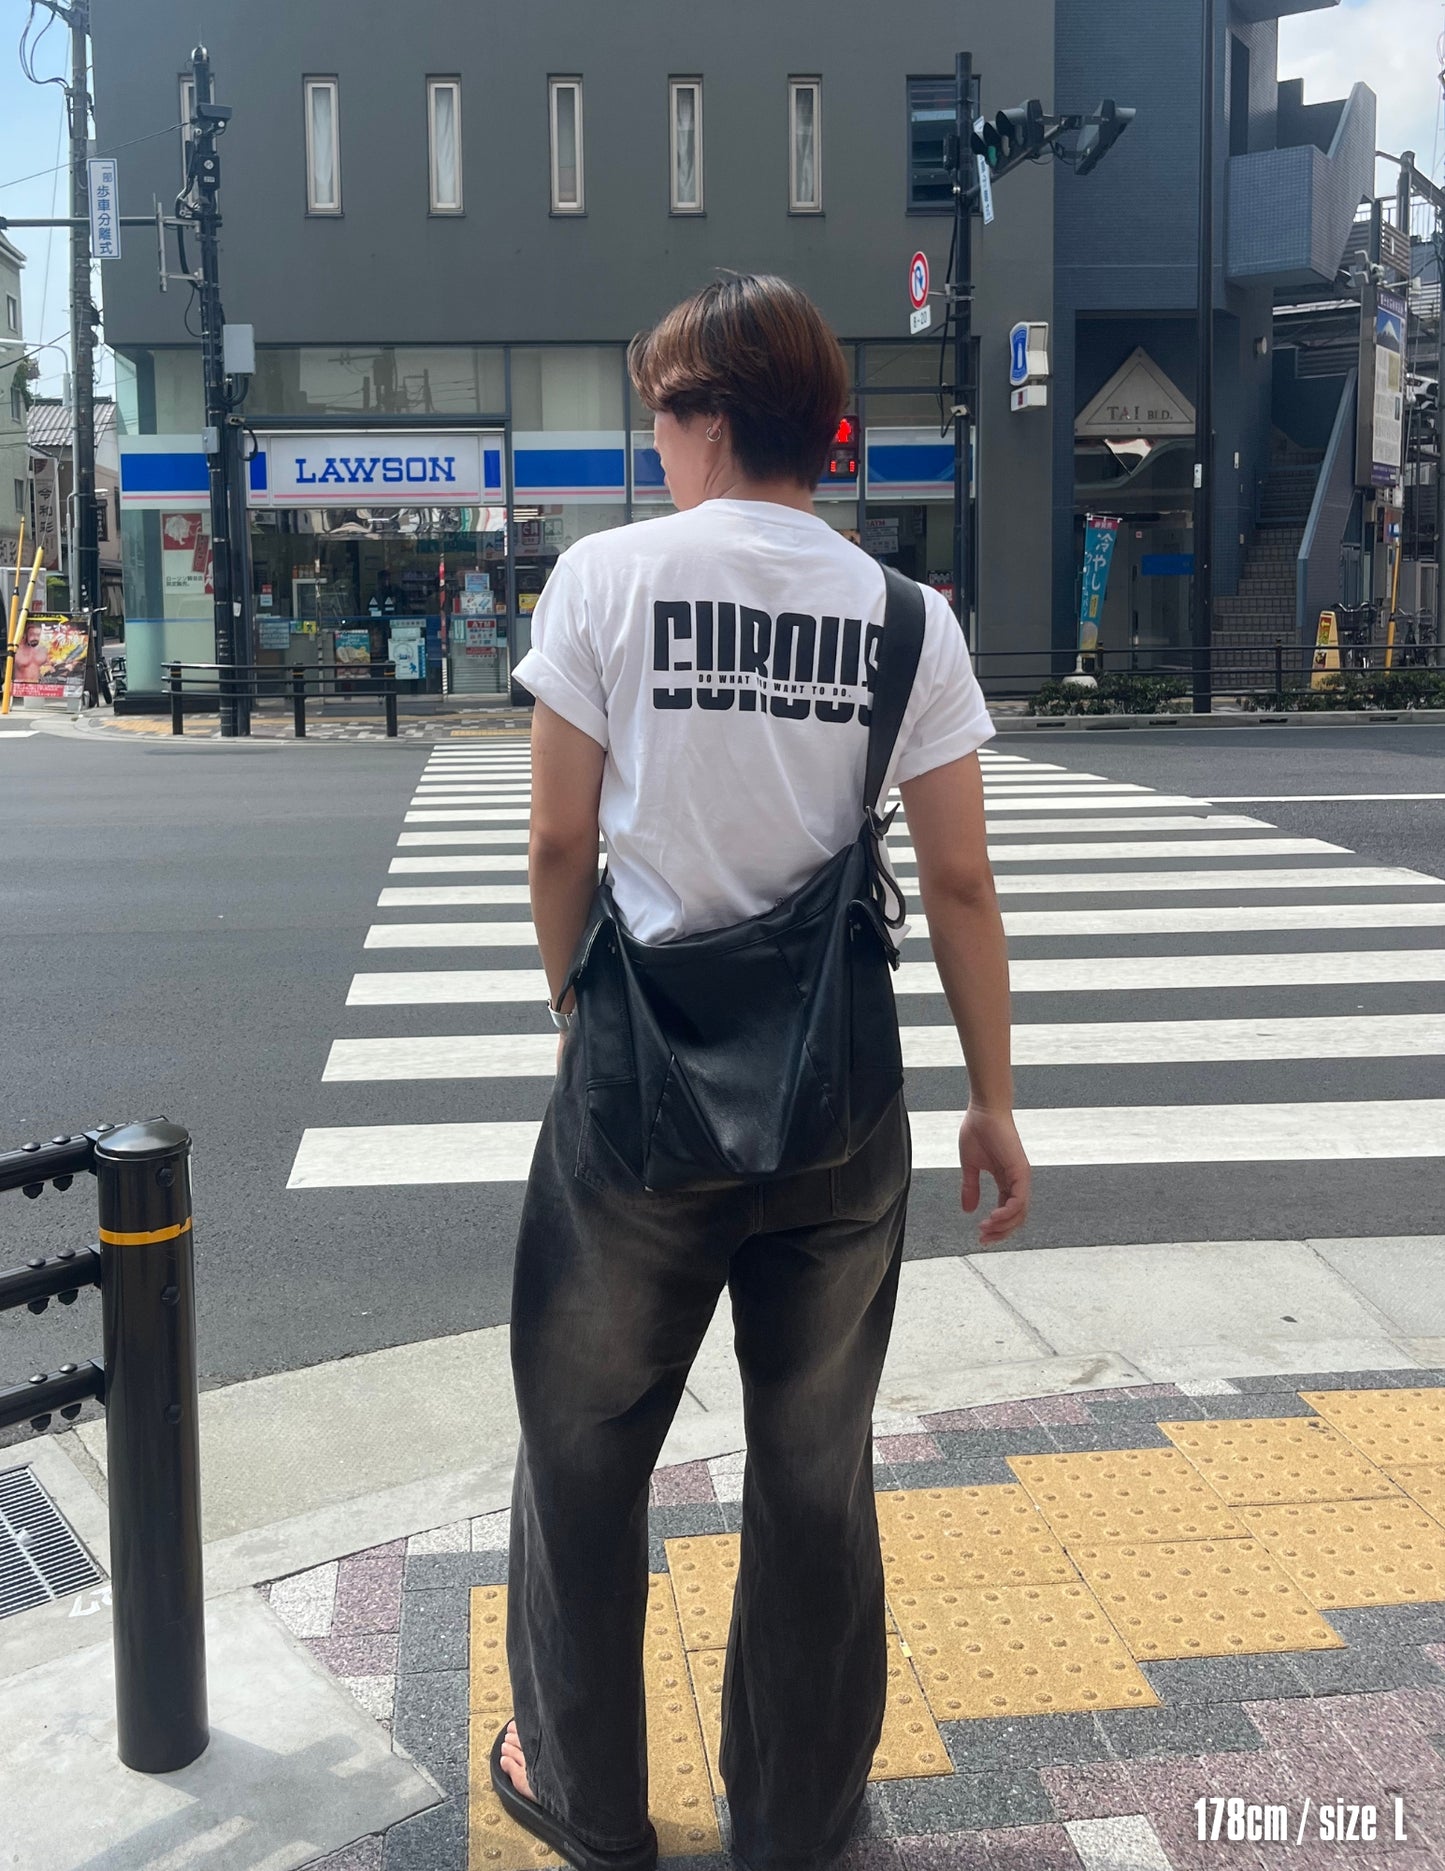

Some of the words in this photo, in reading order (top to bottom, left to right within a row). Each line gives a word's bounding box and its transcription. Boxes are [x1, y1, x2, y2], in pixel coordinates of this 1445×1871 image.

[1106, 406, 1140, 421] TAI
[295, 456, 456, 483] LAWSON
[1090, 532, 1114, 591] 冷やし
[698, 674, 712, 683] DO
[719, 675, 750, 684] WHAT
[774, 683, 805, 694] WANT
[812, 686, 825, 695] TO
[832, 687, 852, 698] DO.
